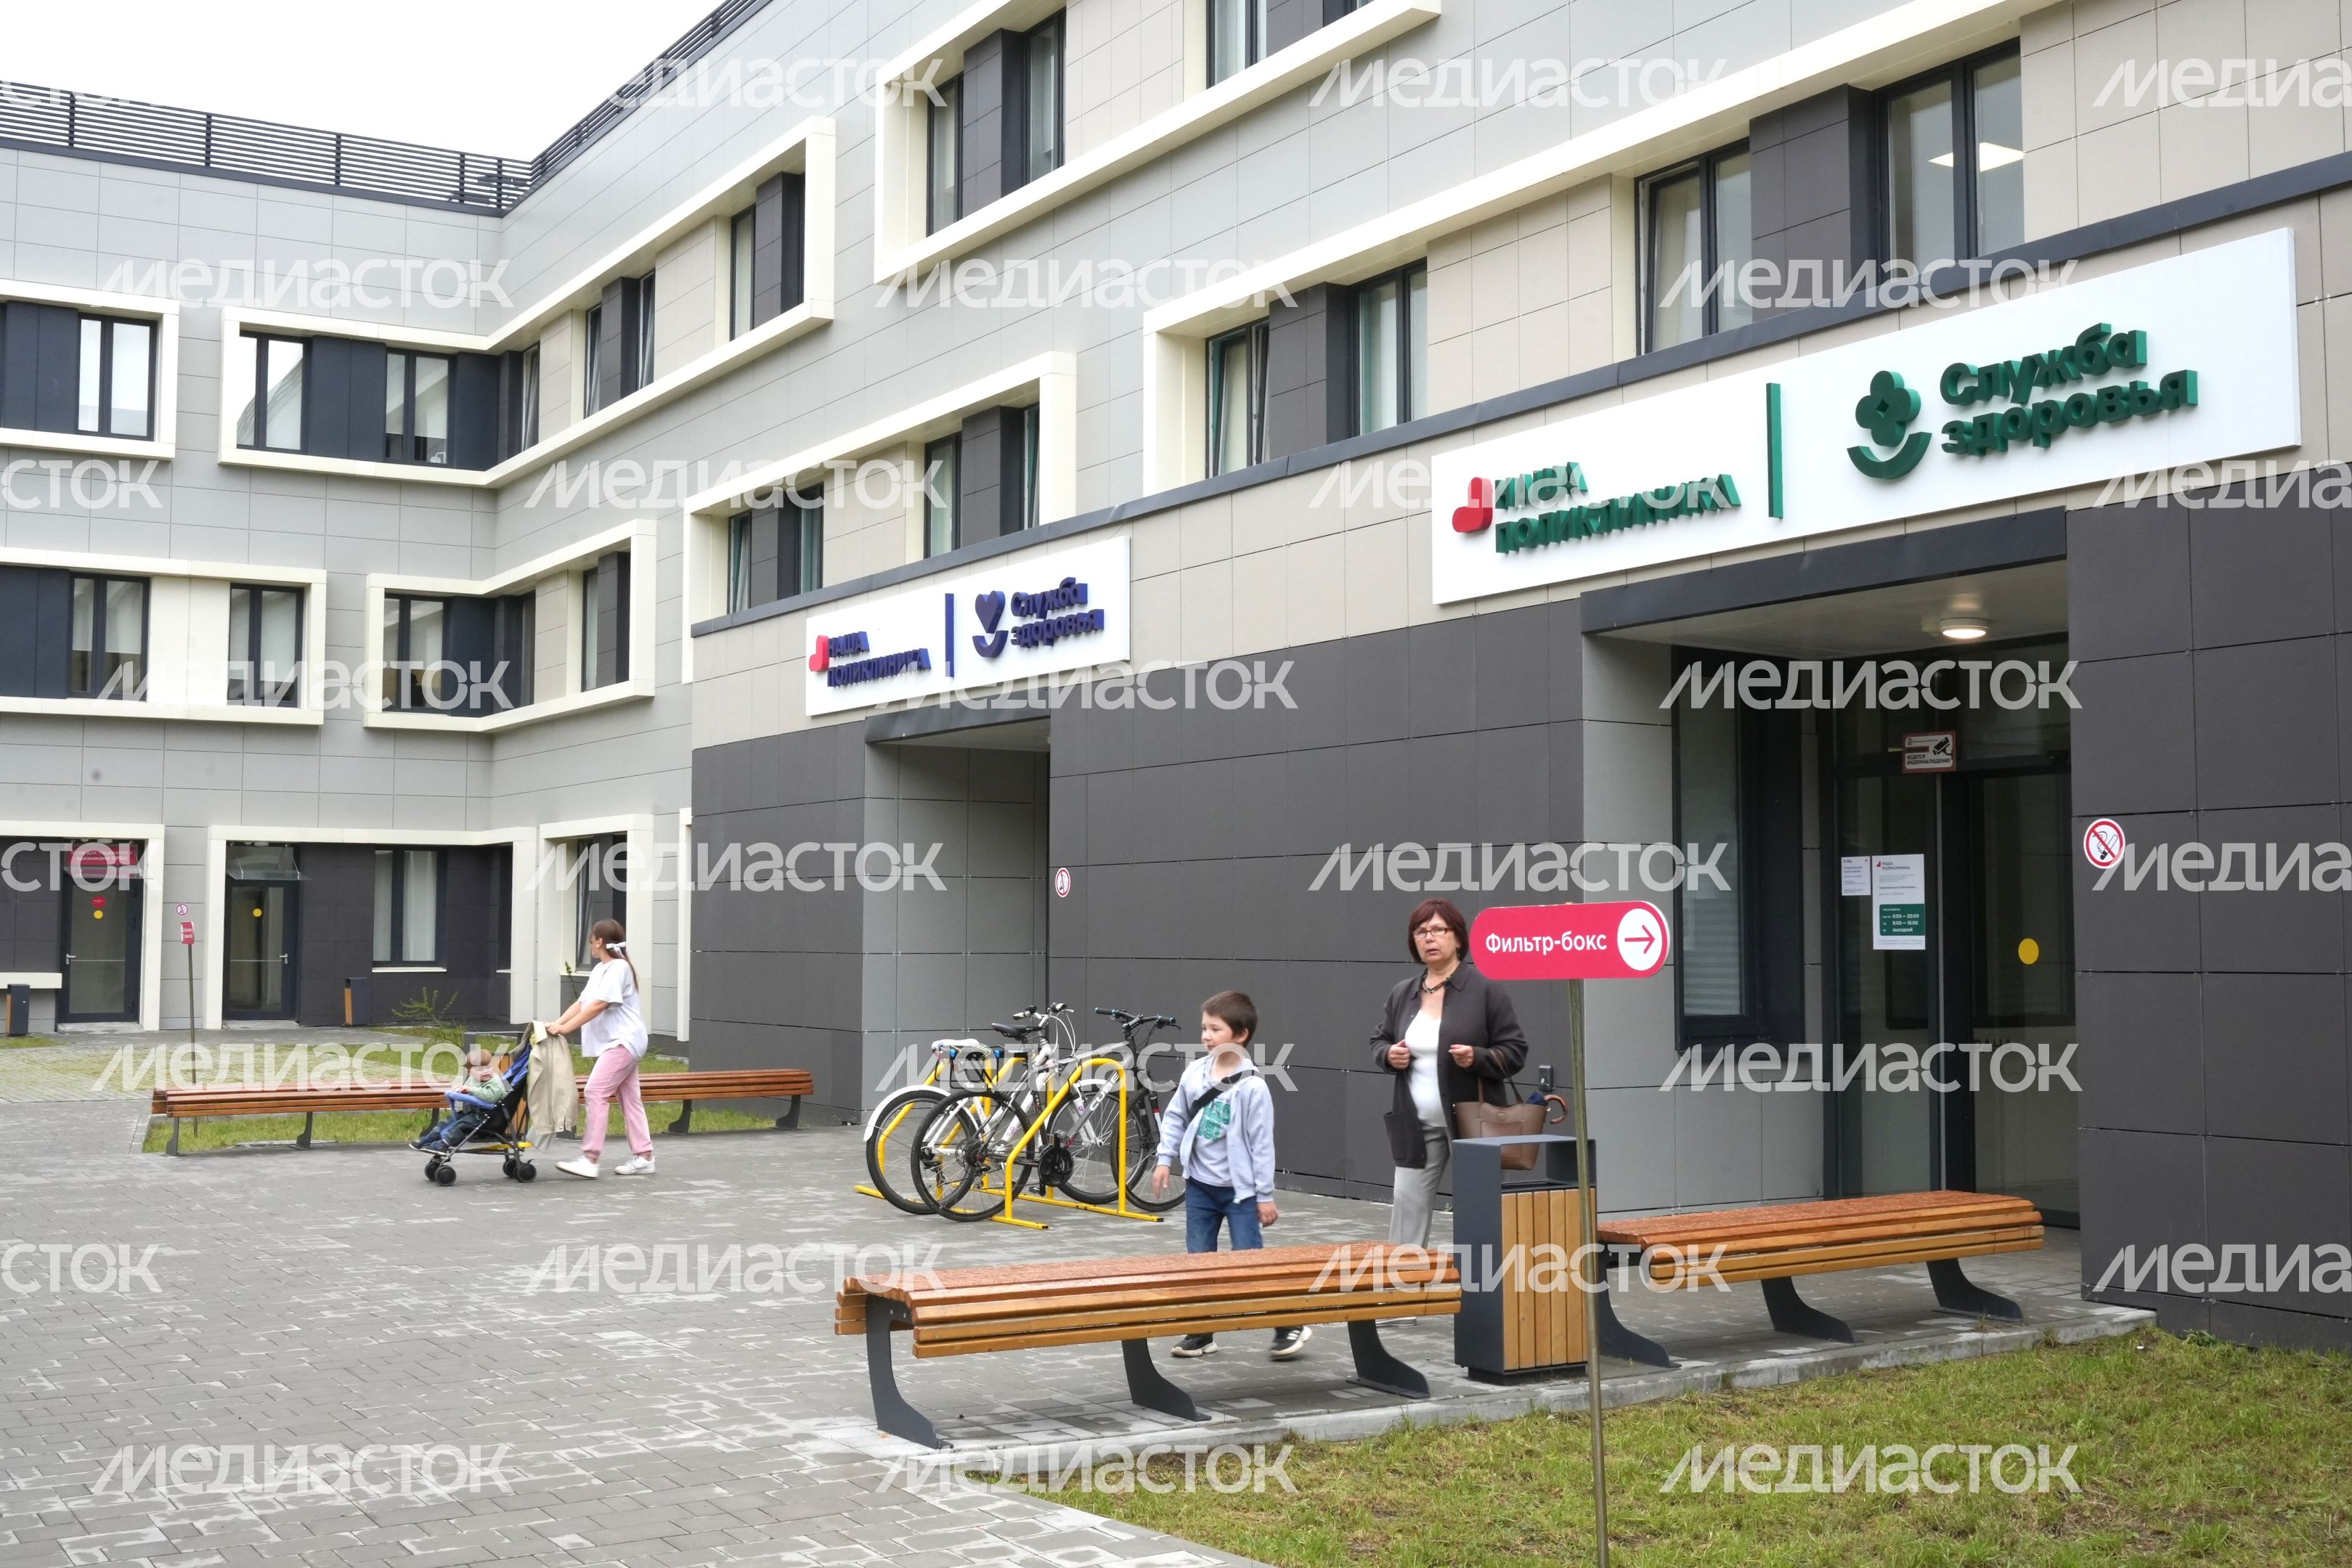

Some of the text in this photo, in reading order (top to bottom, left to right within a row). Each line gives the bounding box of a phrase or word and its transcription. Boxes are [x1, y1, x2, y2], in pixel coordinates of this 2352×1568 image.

[1940, 322, 2147, 405] Служба
[1941, 369, 2198, 456] здоровья
[1496, 474, 1741, 554] ПОЛИКЛИНИКА
[1011, 577, 1088, 618] Служба
[829, 631, 870, 658] НАША
[1011, 609, 1104, 647] здоровья
[827, 648, 932, 687] ПОЛИКЛИНИКА
[1486, 931, 1608, 955] Фильтр-бокс
[1089, 1071, 1119, 1111] CUBE
